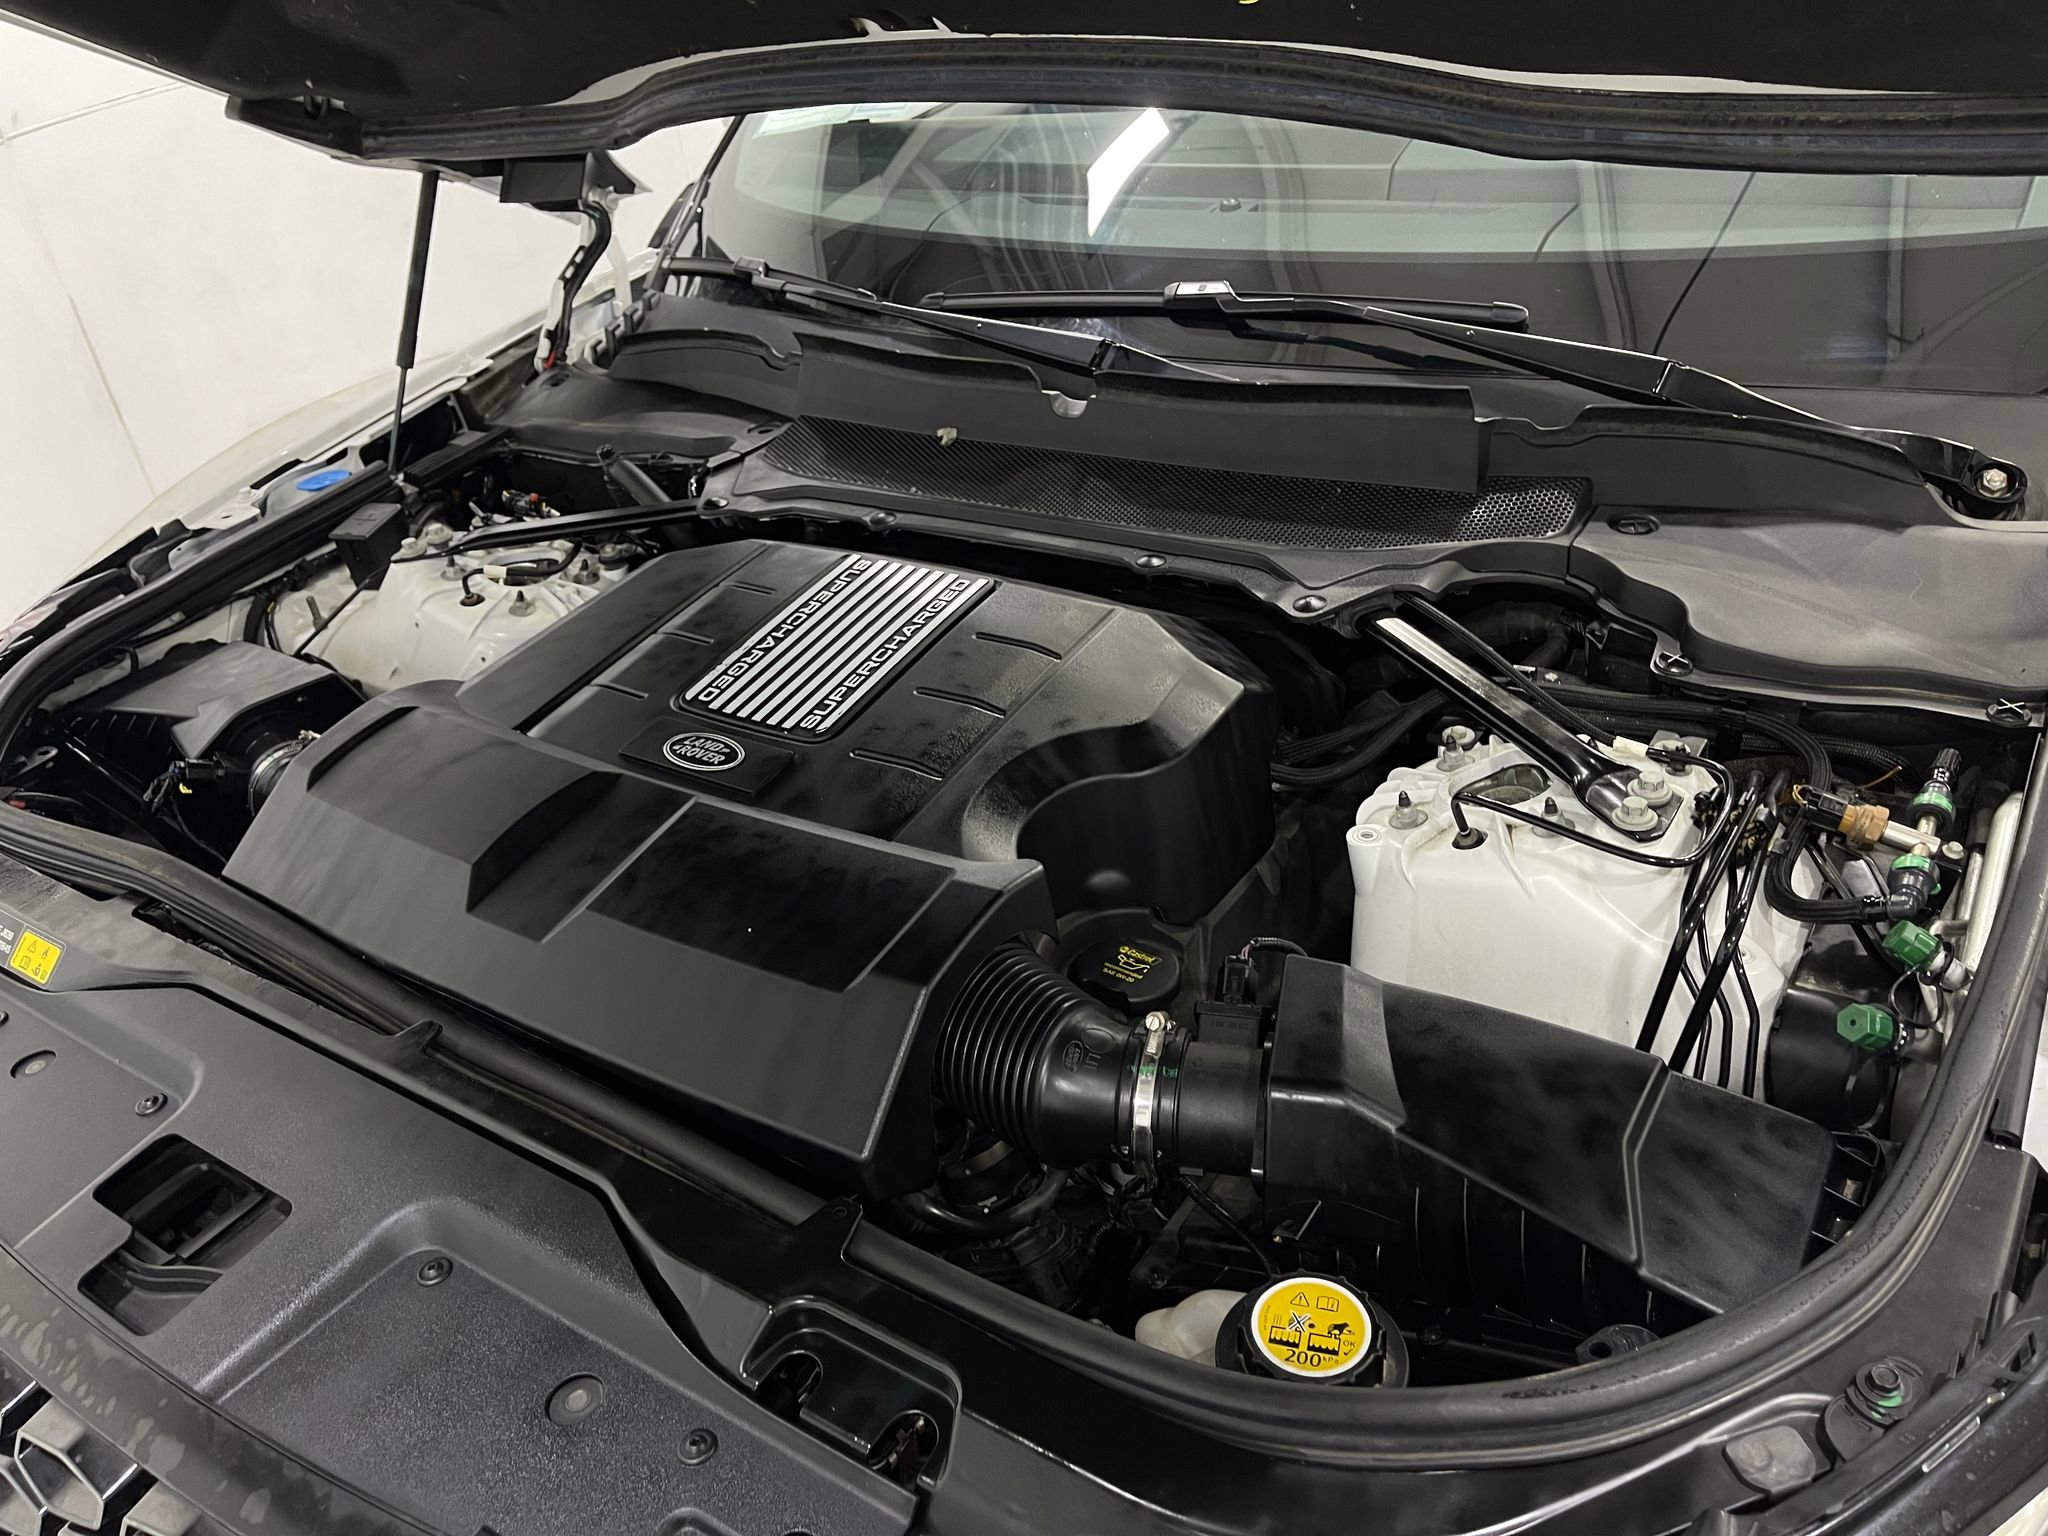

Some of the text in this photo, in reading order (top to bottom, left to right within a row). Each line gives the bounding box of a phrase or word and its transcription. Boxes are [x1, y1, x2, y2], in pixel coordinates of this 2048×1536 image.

[698, 559, 872, 702] SUPERCHARGED
[799, 578, 971, 729] SUPERCHARGED
[683, 736, 725, 752] LAND
[676, 745, 726, 765] ROVER
[1342, 1340, 1356, 1348] OK
[1284, 1348, 1339, 1368] 200 kPa
